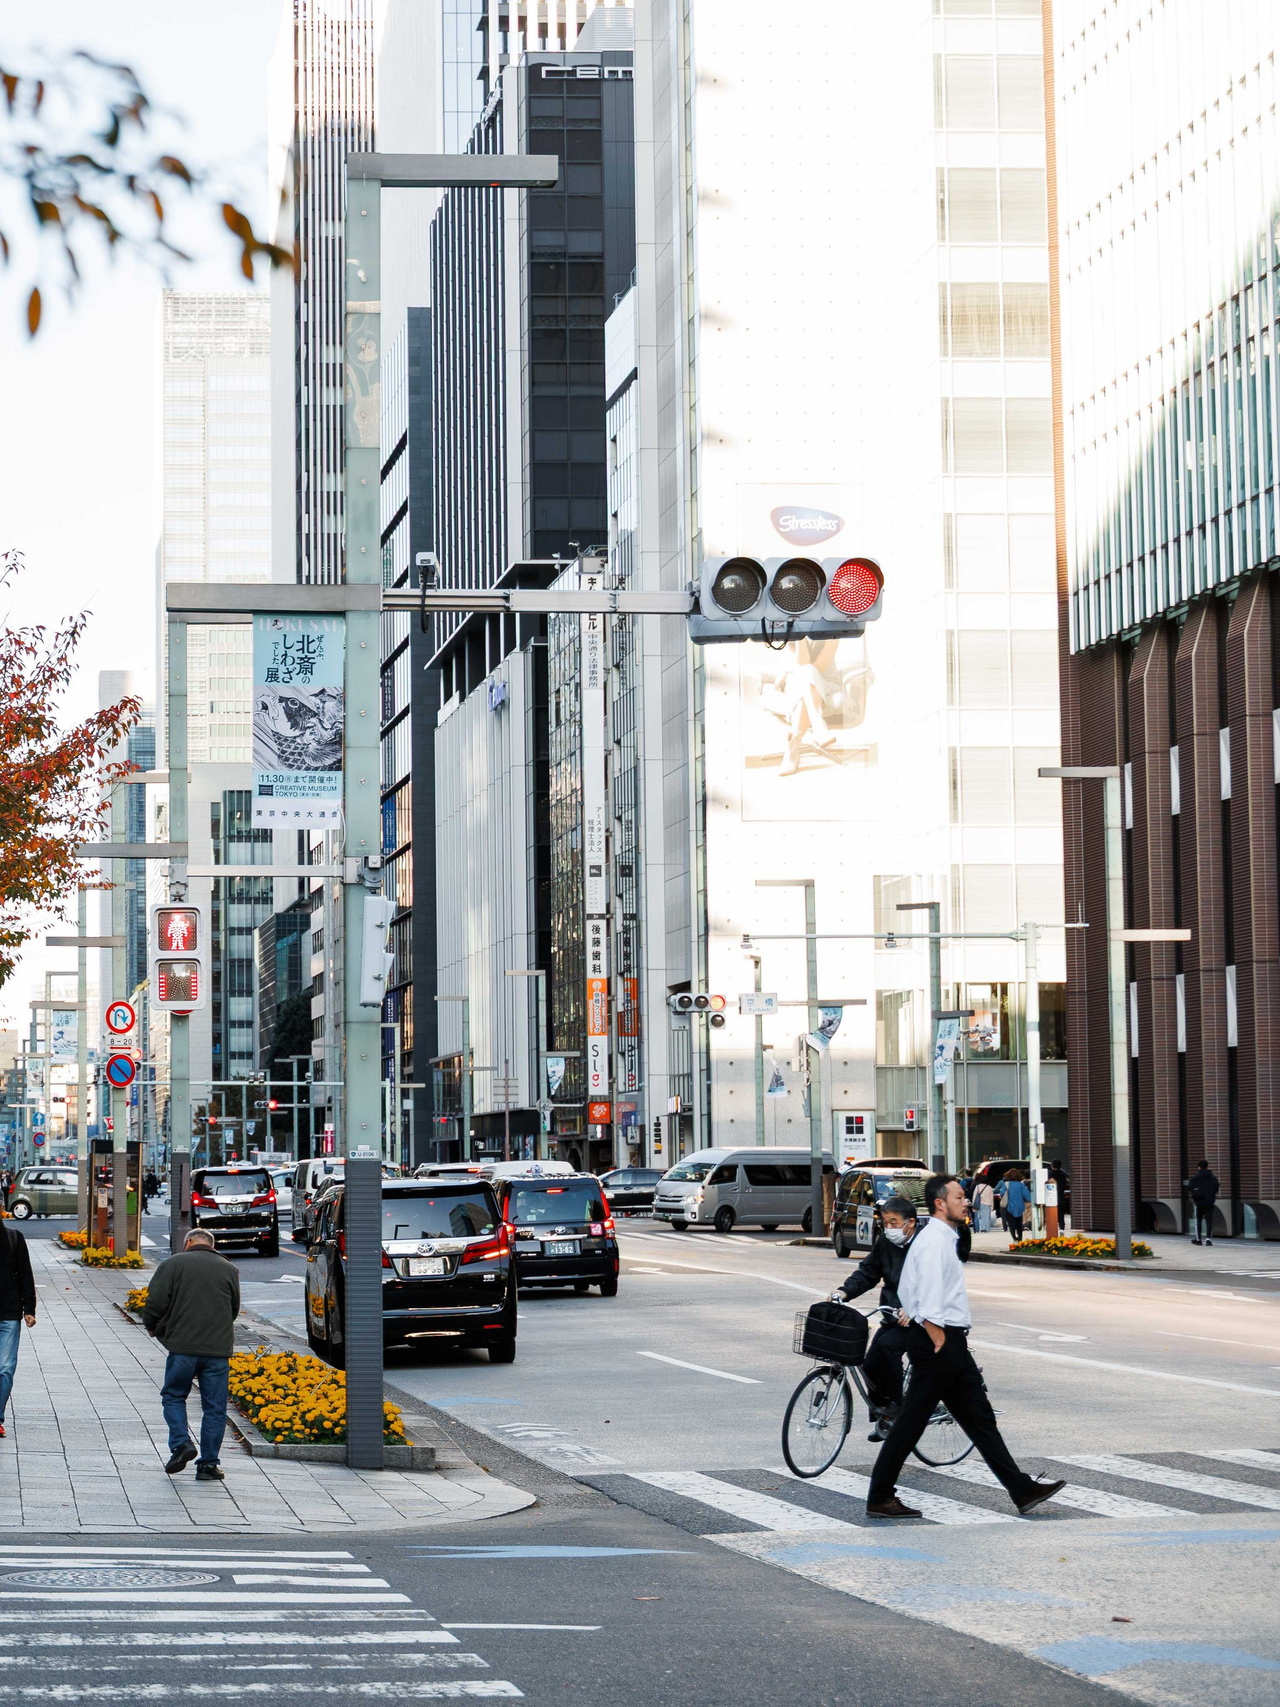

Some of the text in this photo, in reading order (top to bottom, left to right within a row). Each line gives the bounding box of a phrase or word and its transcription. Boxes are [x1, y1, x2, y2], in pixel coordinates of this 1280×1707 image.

[778, 514, 840, 533] Stressless
[259, 617, 337, 632] HOKUSAI
[280, 633, 297, 684] しわざ
[295, 634, 317, 684] 北斎の
[590, 923, 602, 975] 後藤歯科
